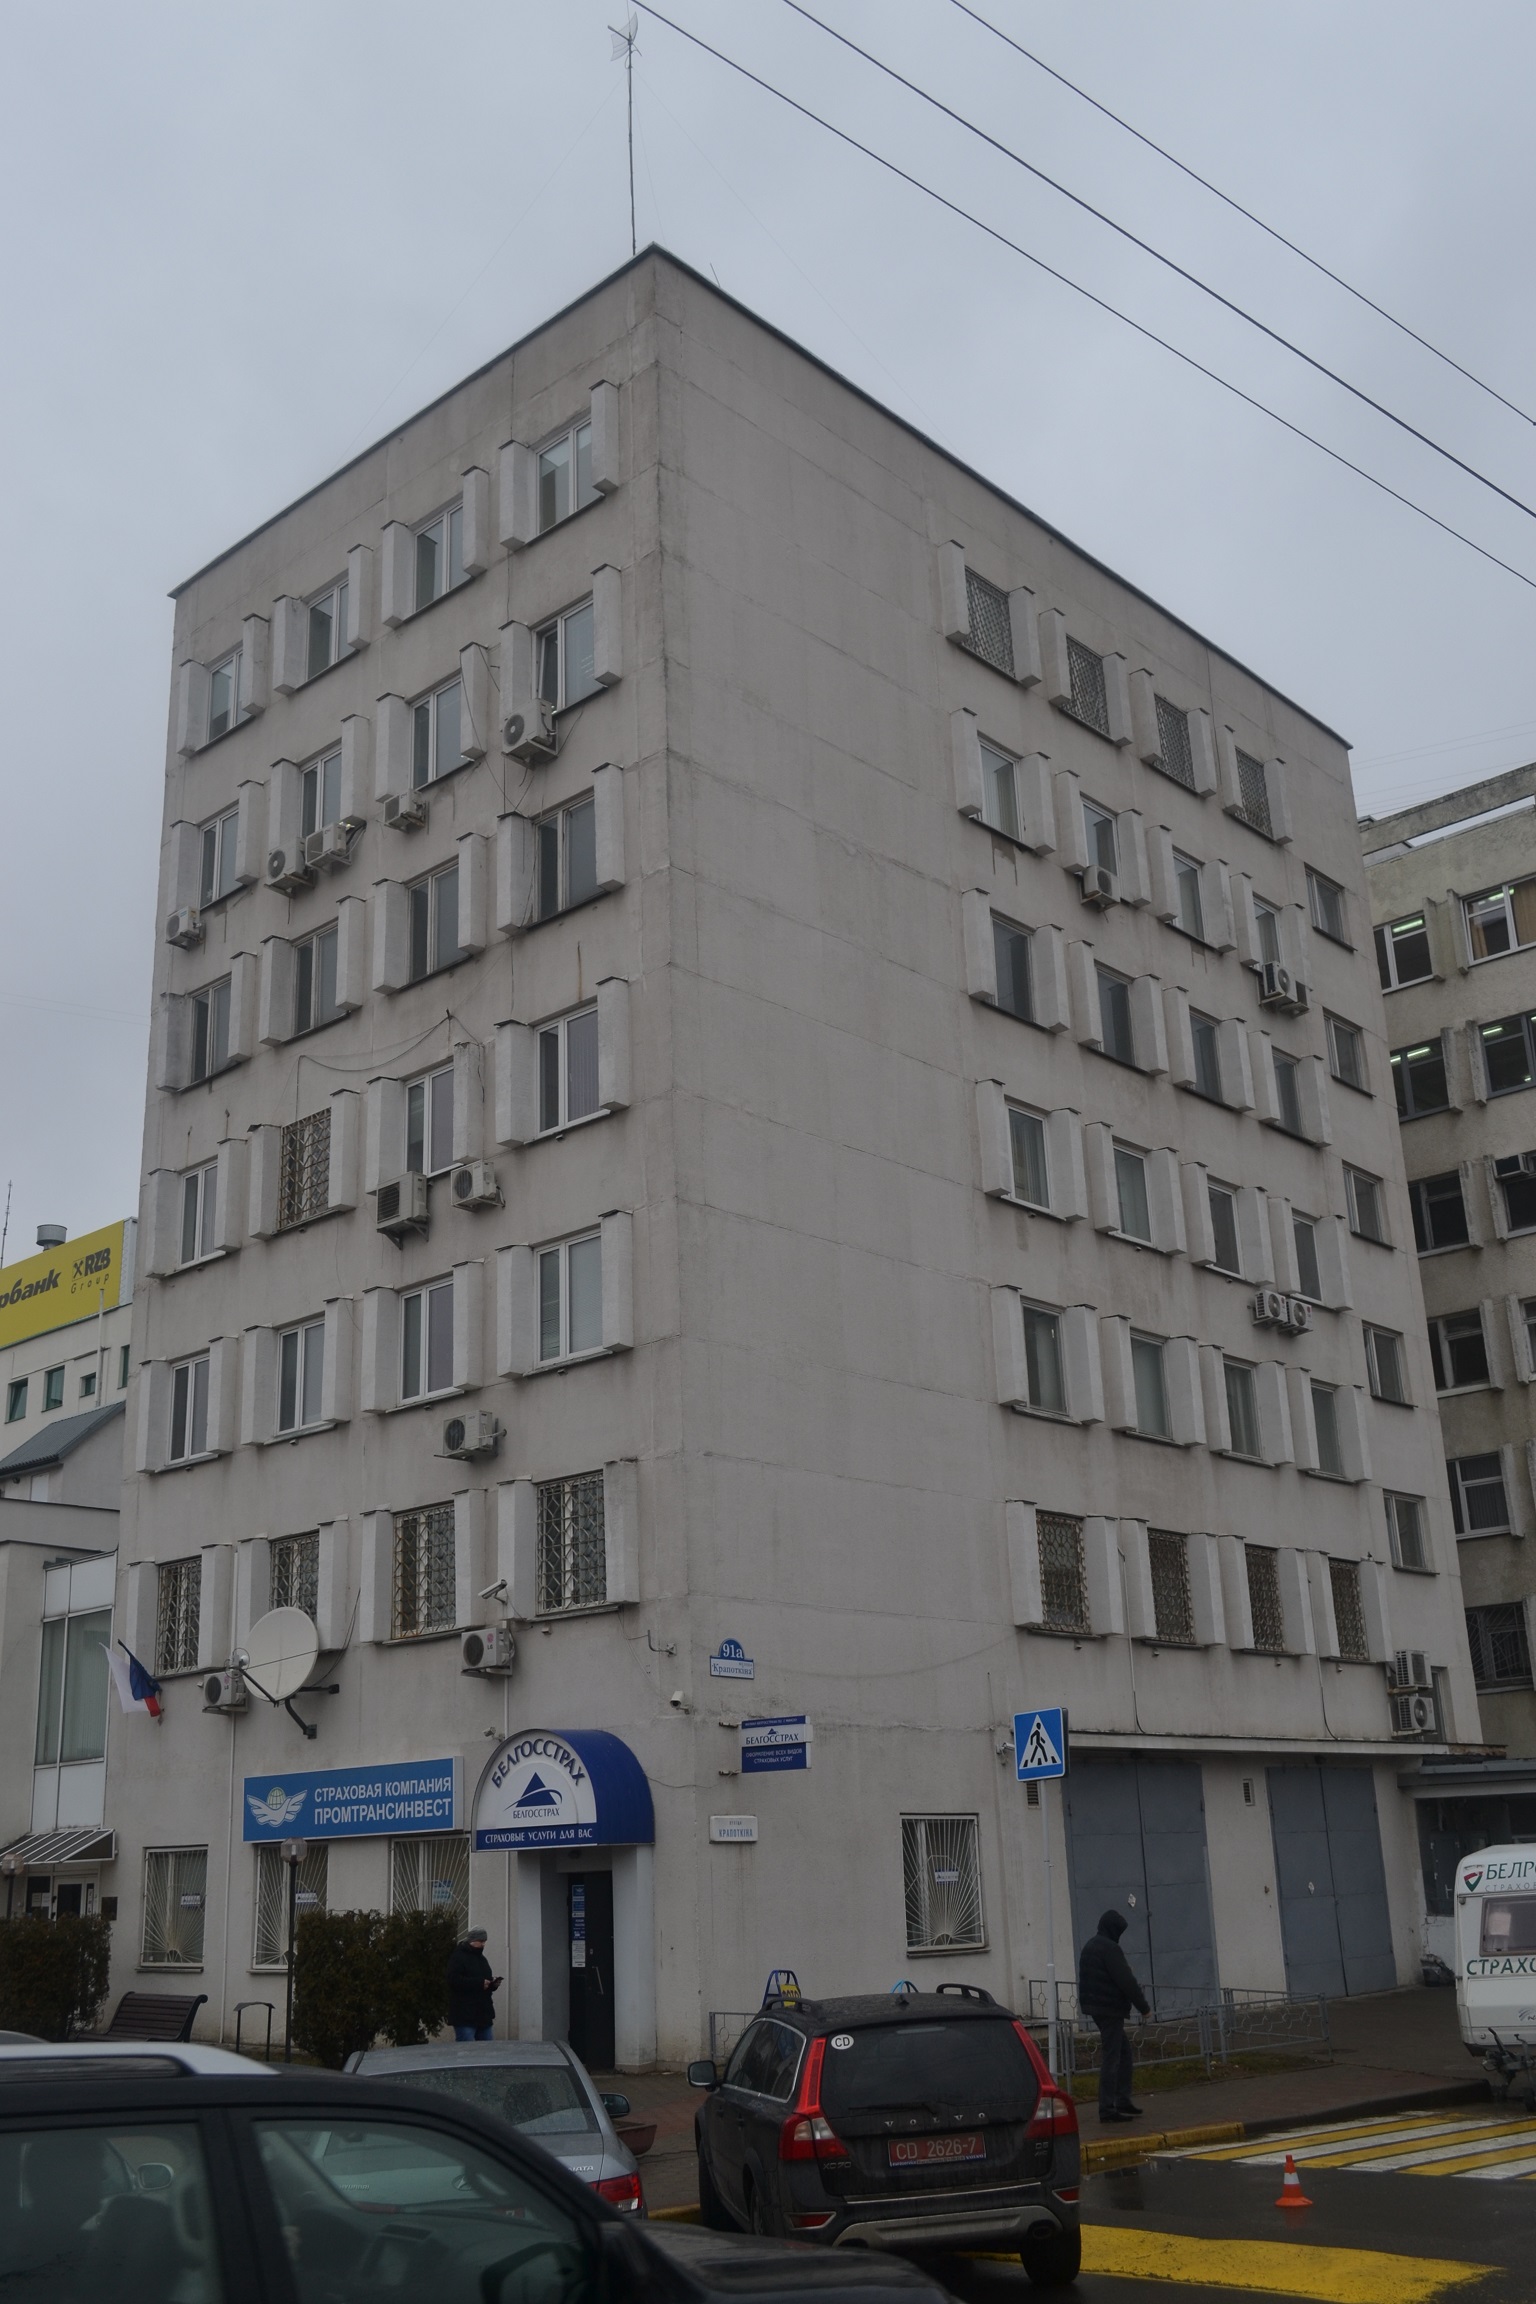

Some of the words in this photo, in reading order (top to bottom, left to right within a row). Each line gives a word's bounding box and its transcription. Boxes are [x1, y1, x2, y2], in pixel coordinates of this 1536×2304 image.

[84, 1248, 111, 1277] RZB
[71, 1273, 109, 1294] Group
[745, 1733, 799, 1745] БЕЛГОССТРАХ
[491, 1738, 586, 1789] БЕЛГОССТРАХ
[314, 1783, 382, 1802] СТРАХОВАЯ
[385, 1777, 452, 1797] КОМПАНИЯ
[314, 1798, 452, 1825] ПРОМТРАНСИНВЕСТ
[512, 1808, 560, 1819] БЕЛГОССТРАХ
[485, 1832, 525, 1844] СТРАХОВЫЕ
[528, 1830, 556, 1841] УСЛУГИ
[559, 1829, 575, 1839] ДЛЯ
[578, 1828, 593, 1838] ВАС
[1486, 1861, 1536, 1880] БЕЛР
[835, 2036, 850, 2048] CD
[884, 2112, 986, 2127] VOLVO
[896, 2142, 918, 2160] CD
[927, 2137, 977, 2158] 2626-7
[822, 2161, 852, 2170] XC70
